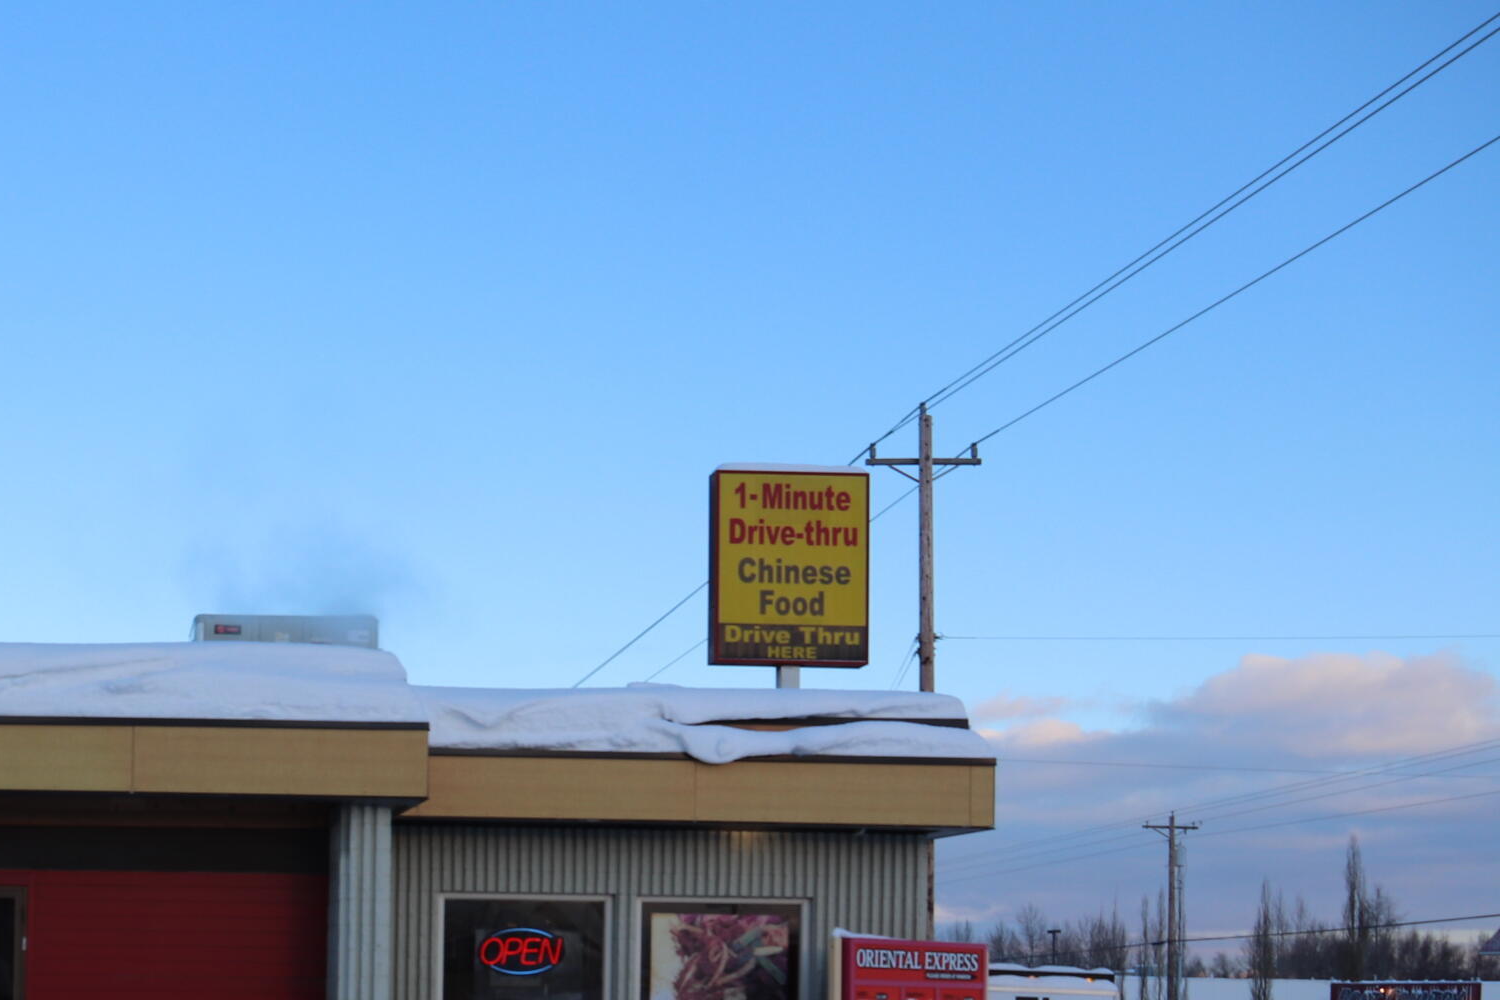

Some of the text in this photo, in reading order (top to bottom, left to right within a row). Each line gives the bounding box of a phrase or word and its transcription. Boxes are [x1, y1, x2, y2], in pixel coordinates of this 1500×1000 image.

[728, 517, 859, 547] Drive-thru
[738, 556, 852, 585] Chinese
[759, 590, 825, 616] Food
[724, 625, 861, 645] Drive Thru
[767, 646, 817, 659] HERE
[479, 936, 564, 966] OPEN
[856, 948, 979, 972] ORIENTAL EXPRESS
